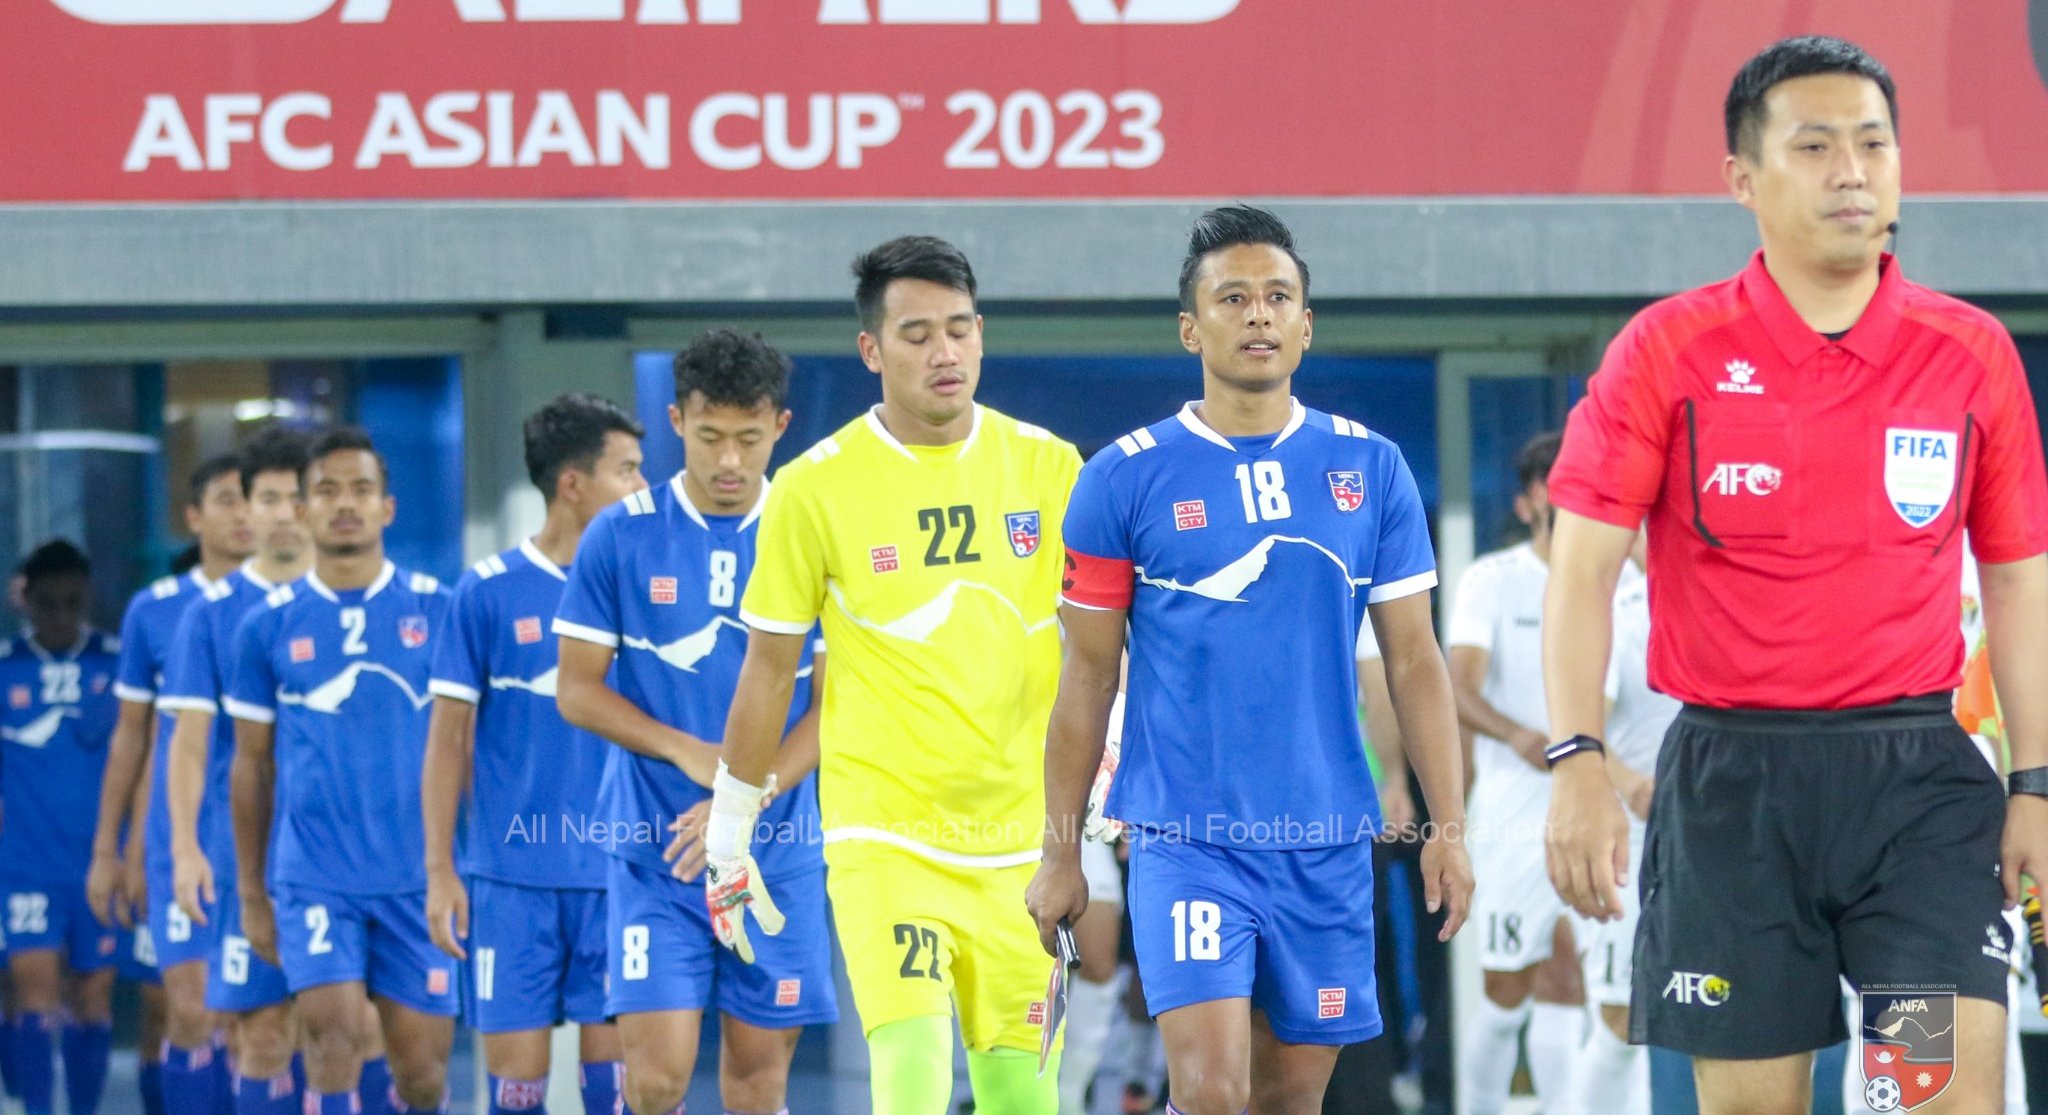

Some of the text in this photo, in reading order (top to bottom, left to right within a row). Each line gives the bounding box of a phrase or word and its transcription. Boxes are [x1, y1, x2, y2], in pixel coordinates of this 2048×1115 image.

[121, 92, 333, 171] AFC
[353, 90, 671, 169] ASIAN
[688, 91, 901, 170] CUP
[943, 89, 1165, 169] 2023
[1894, 435, 1947, 460] FIFA
[1234, 460, 1292, 524] 18
[1702, 462, 1782, 497] AFC
[1177, 503, 1202, 514] KTM
[1179, 516, 1203, 528] CTY
[873, 547, 895, 559] KTM
[917, 504, 981, 567] 22
[708, 550, 737, 608] 8
[875, 560, 898, 572] CTY
[340, 607, 368, 655] 2
[305, 904, 333, 955] 2
[1170, 900, 1221, 962] 18
[1487, 911, 1522, 953] 18
[623, 924, 650, 981] 8
[893, 923, 943, 983] 22
[475, 947, 496, 1001] 11
[1662, 970, 1732, 1006] AFC
[1031, 1003, 1045, 1012] KT
[1321, 991, 1343, 1001] KTM
[1321, 1006, 1342, 1016] CTY
[1028, 1014, 1043, 1024] CT
